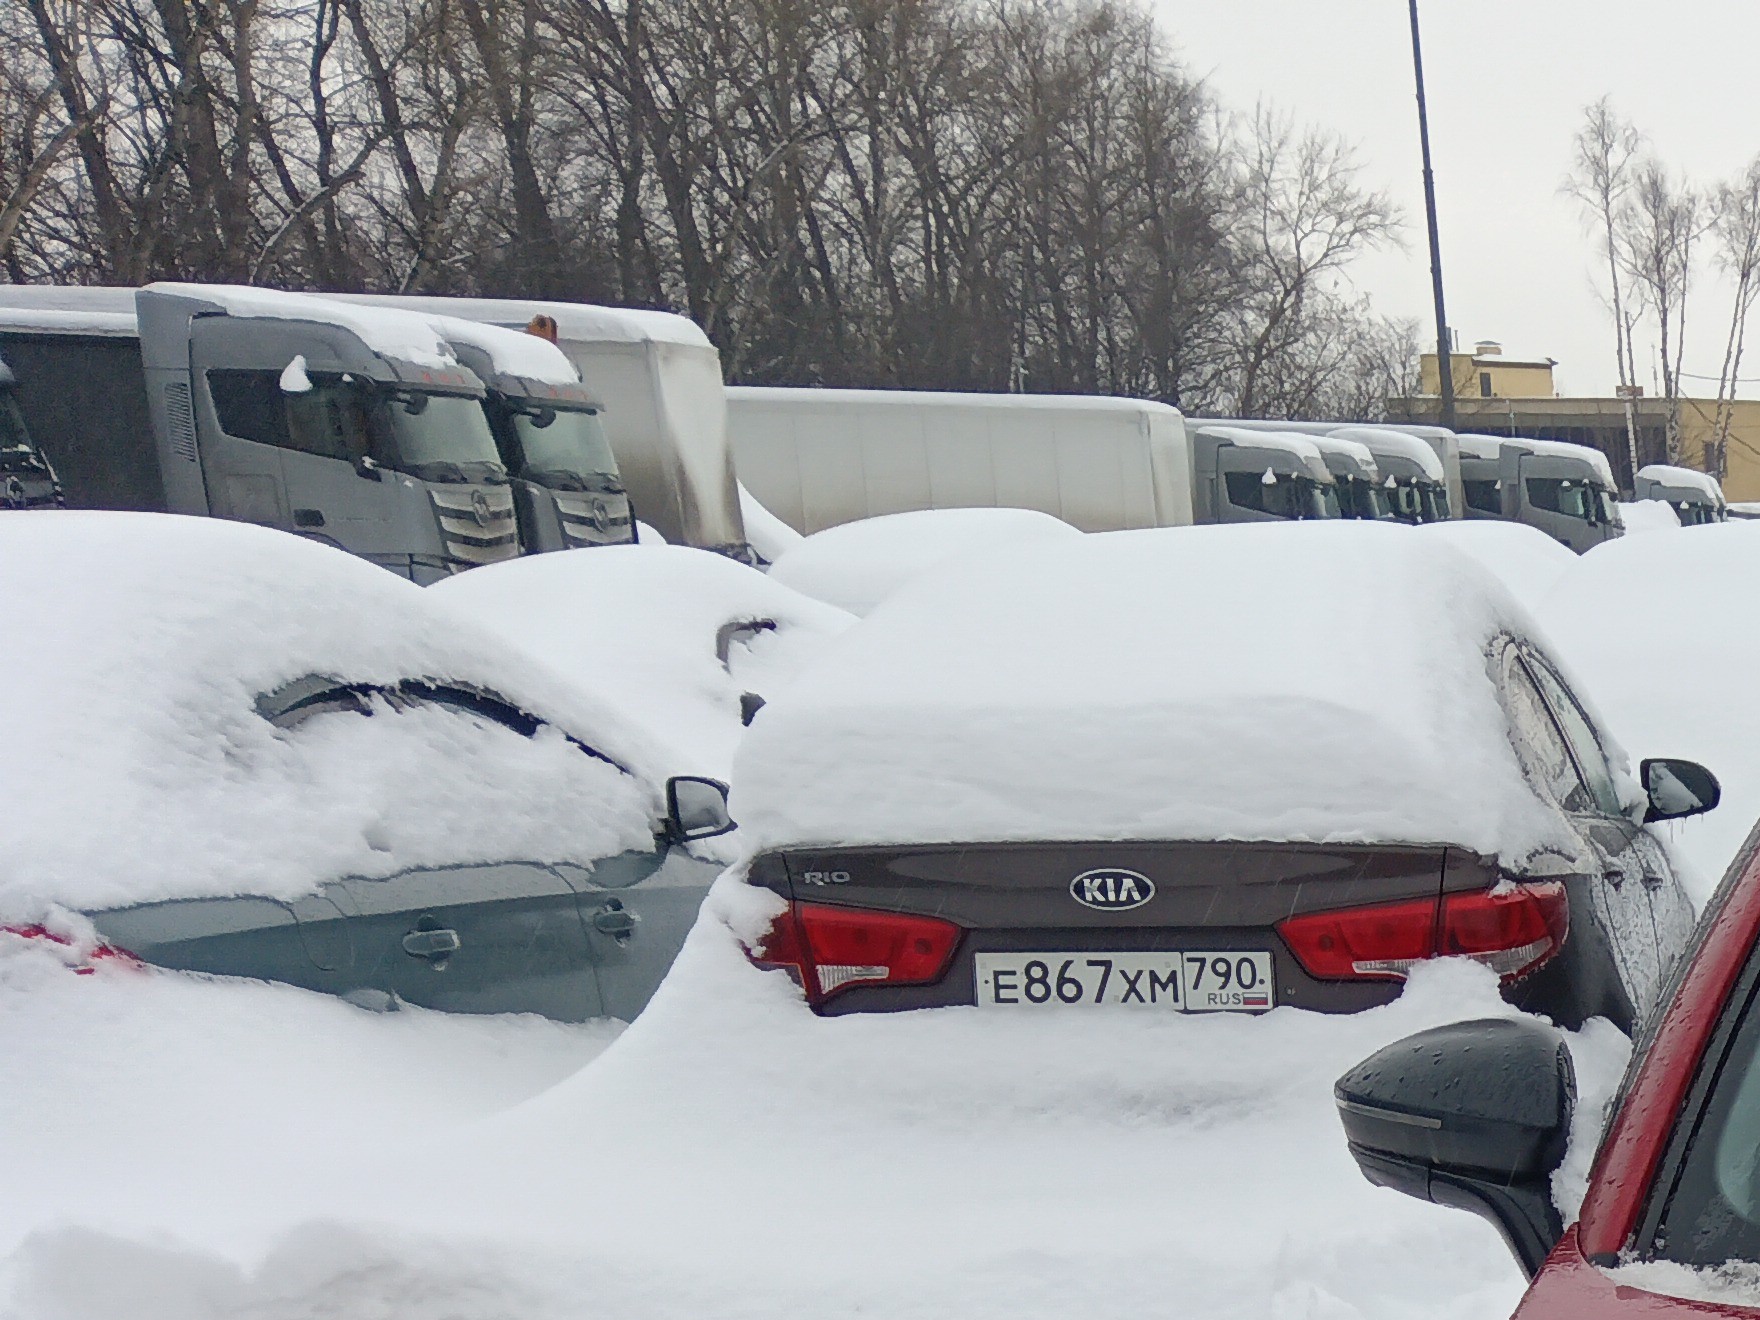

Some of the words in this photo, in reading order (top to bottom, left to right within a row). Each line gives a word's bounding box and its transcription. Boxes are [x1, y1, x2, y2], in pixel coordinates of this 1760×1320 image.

[803, 871, 850, 885] RIO
[1082, 878, 1143, 901] KIA
[992, 959, 1180, 1003] Е867ХМ
[1186, 956, 1258, 990] 790
[1207, 992, 1242, 1005] RUS
